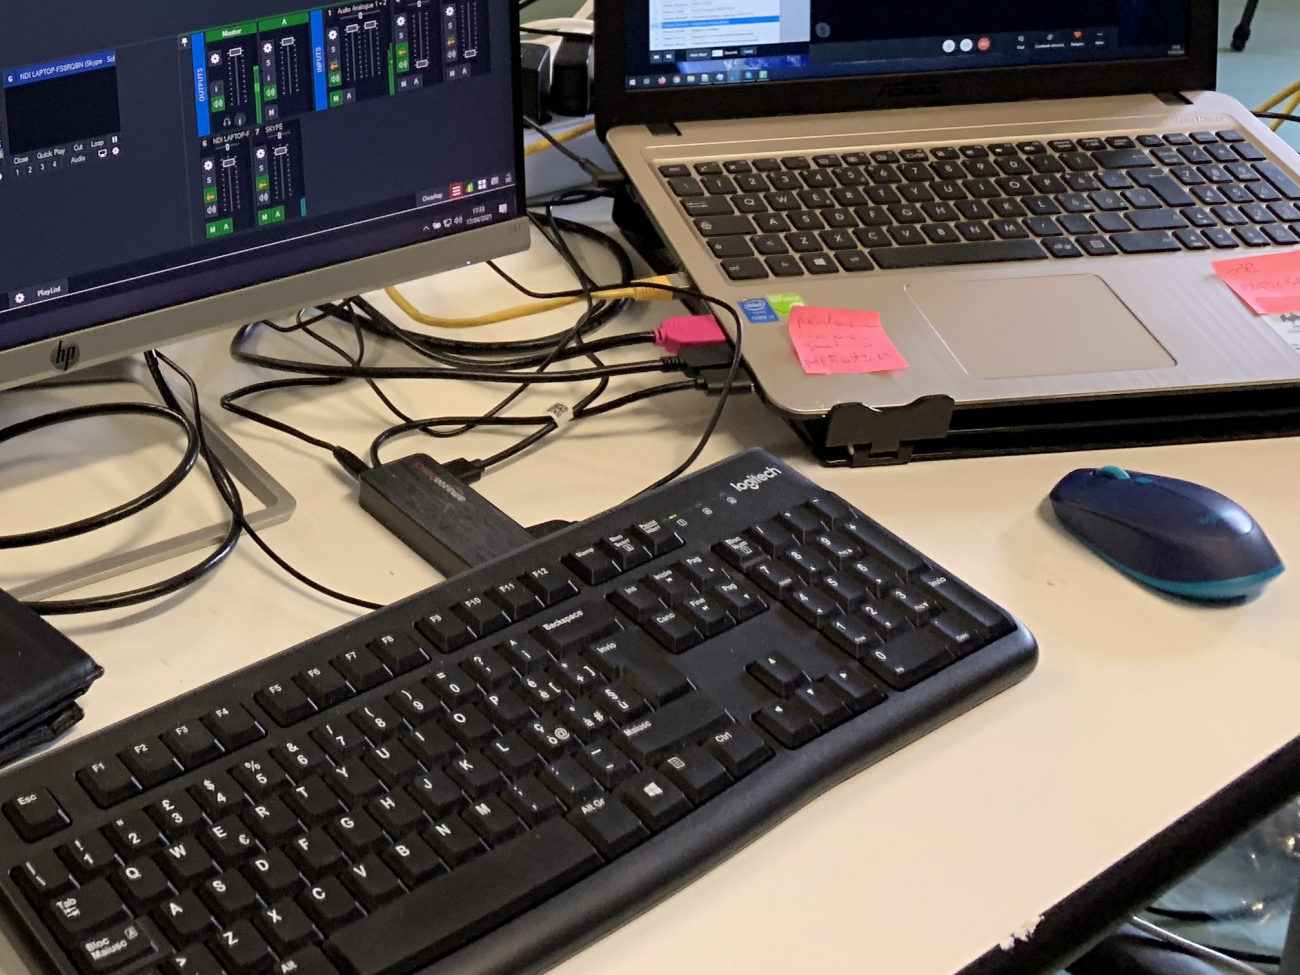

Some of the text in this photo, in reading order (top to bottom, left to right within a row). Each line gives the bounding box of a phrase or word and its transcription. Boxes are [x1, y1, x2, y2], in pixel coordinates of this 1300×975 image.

[221, 26, 242, 37] Master
[196, 67, 205, 102] OUTPUTS
[37, 285, 61, 297] PlayList
[55, 339, 76, 372] hp
[730, 466, 782, 493] logitech
[542, 610, 584, 632] Backspace
[715, 732, 732, 744] Ctrl
[18, 792, 37, 805] Esc
[56, 896, 77, 910] Tab
